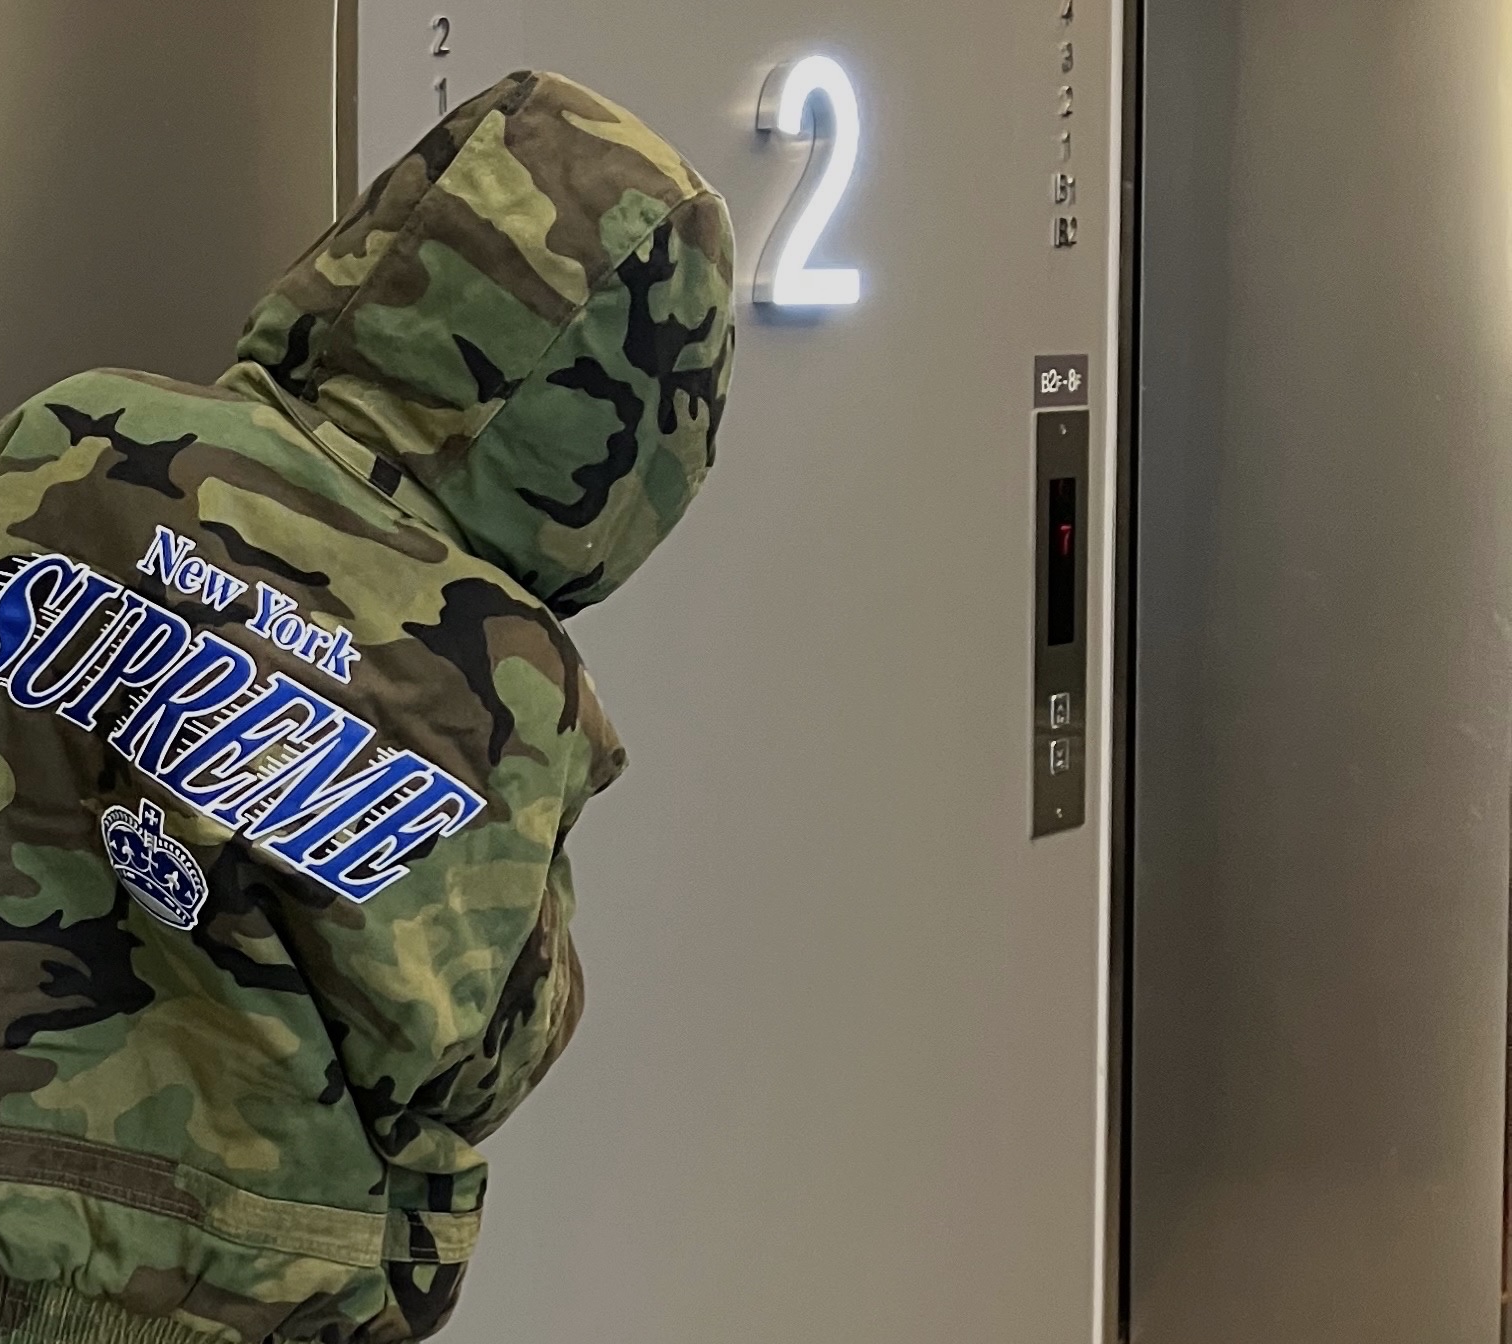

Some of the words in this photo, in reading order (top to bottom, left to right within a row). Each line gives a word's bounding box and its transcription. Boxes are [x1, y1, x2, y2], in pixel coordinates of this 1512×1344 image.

[431, 16, 451, 57] 2
[1060, 41, 1074, 73] 3
[433, 76, 448, 116] 1
[1058, 85, 1074, 118] 2
[756, 55, 860, 305] 2
[136, 525, 248, 612] New
[245, 580, 362, 685] York
